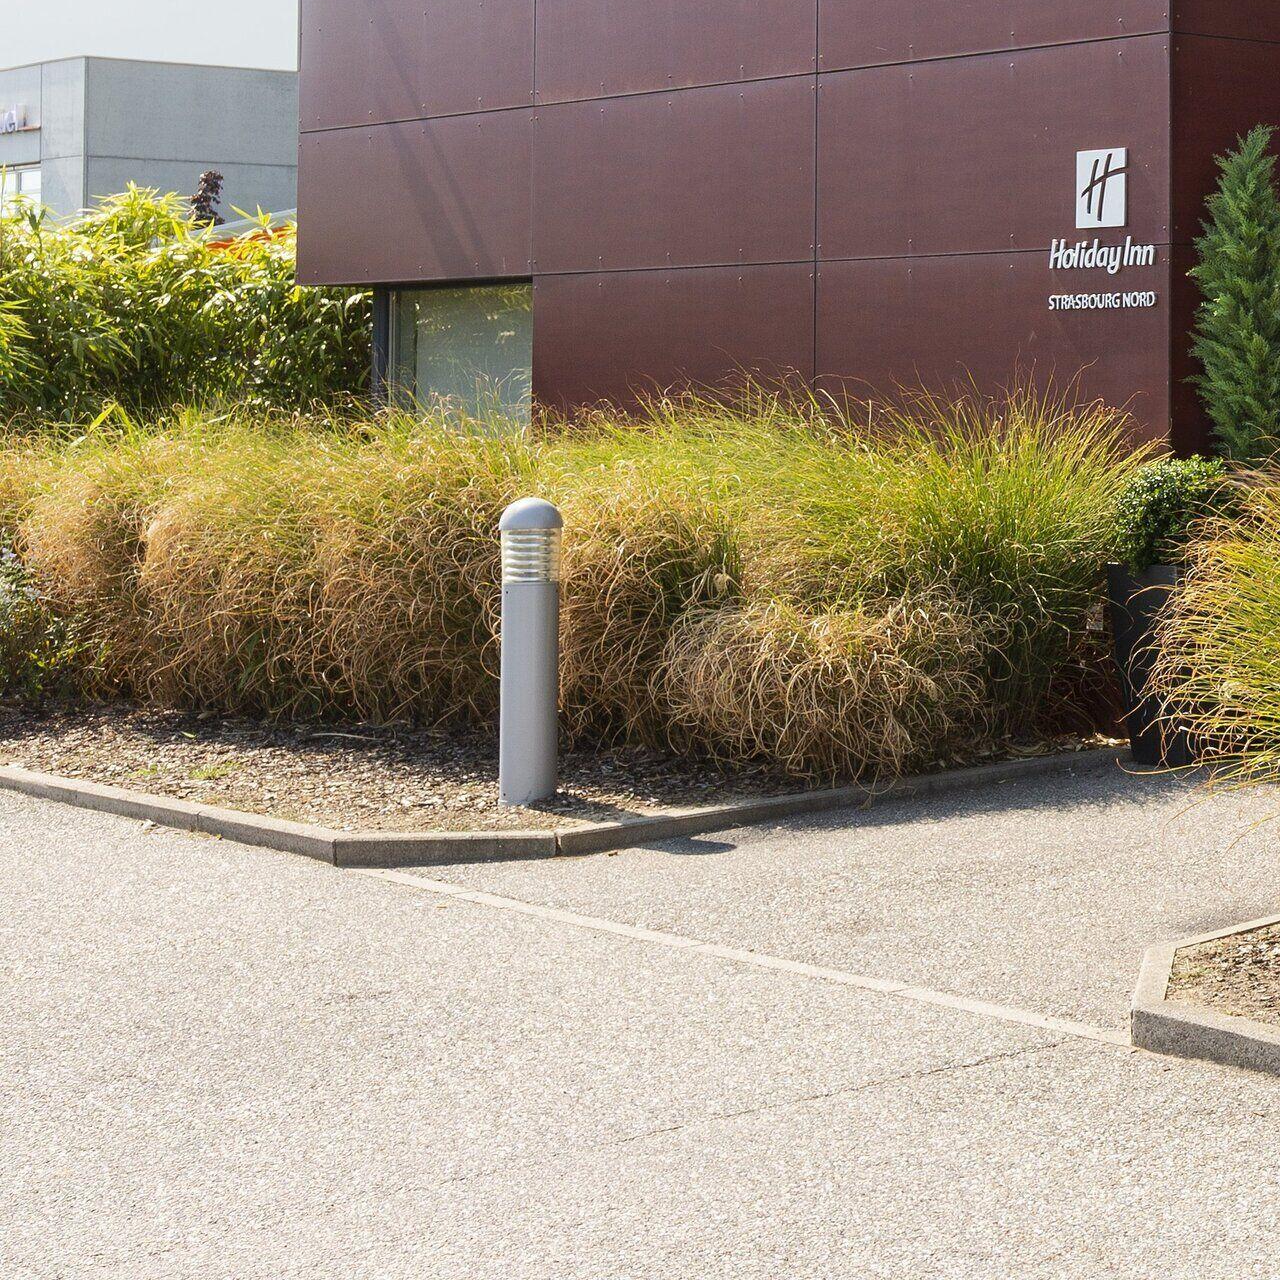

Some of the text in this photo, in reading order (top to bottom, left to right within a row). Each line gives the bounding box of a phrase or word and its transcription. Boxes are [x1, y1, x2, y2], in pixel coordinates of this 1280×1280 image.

[1049, 235, 1156, 274] Holiday Inn
[1048, 290, 1156, 311] STRASBOURG NORD
